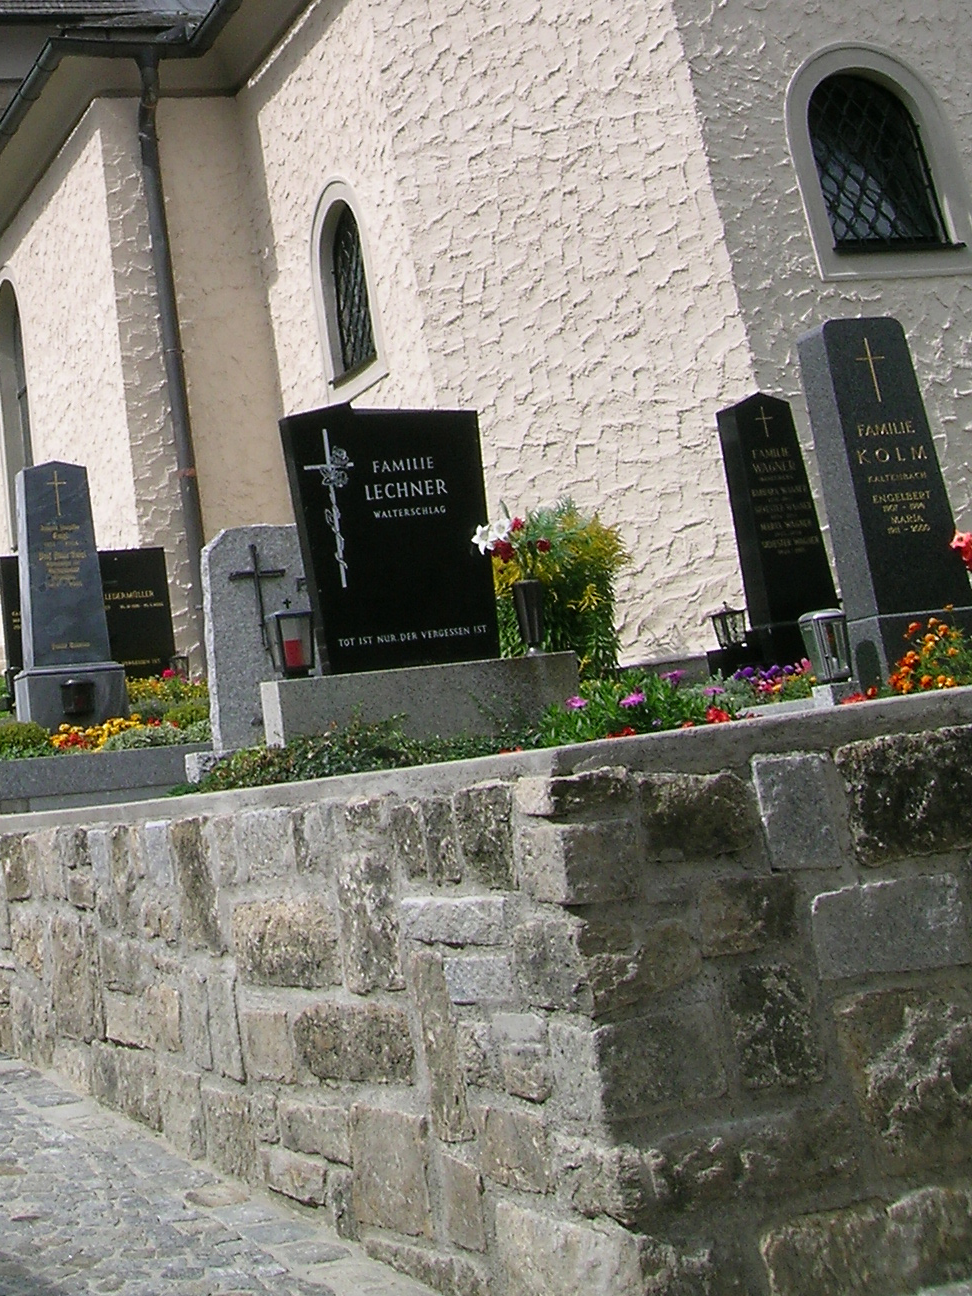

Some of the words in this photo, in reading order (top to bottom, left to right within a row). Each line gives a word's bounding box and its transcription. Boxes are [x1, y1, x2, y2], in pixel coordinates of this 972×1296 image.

[857, 419, 916, 437] FAMILIE
[856, 445, 928, 464] KOLM
[372, 456, 434, 473] FAMILIE
[364, 478, 448, 501] LECHNER
[373, 505, 446, 518] WALTERSCHLAG
[338, 637, 355, 647] TOT
[359, 636, 372, 645] IST
[421, 627, 470, 639] VERGESSEN
[473, 625, 488, 633] IST
